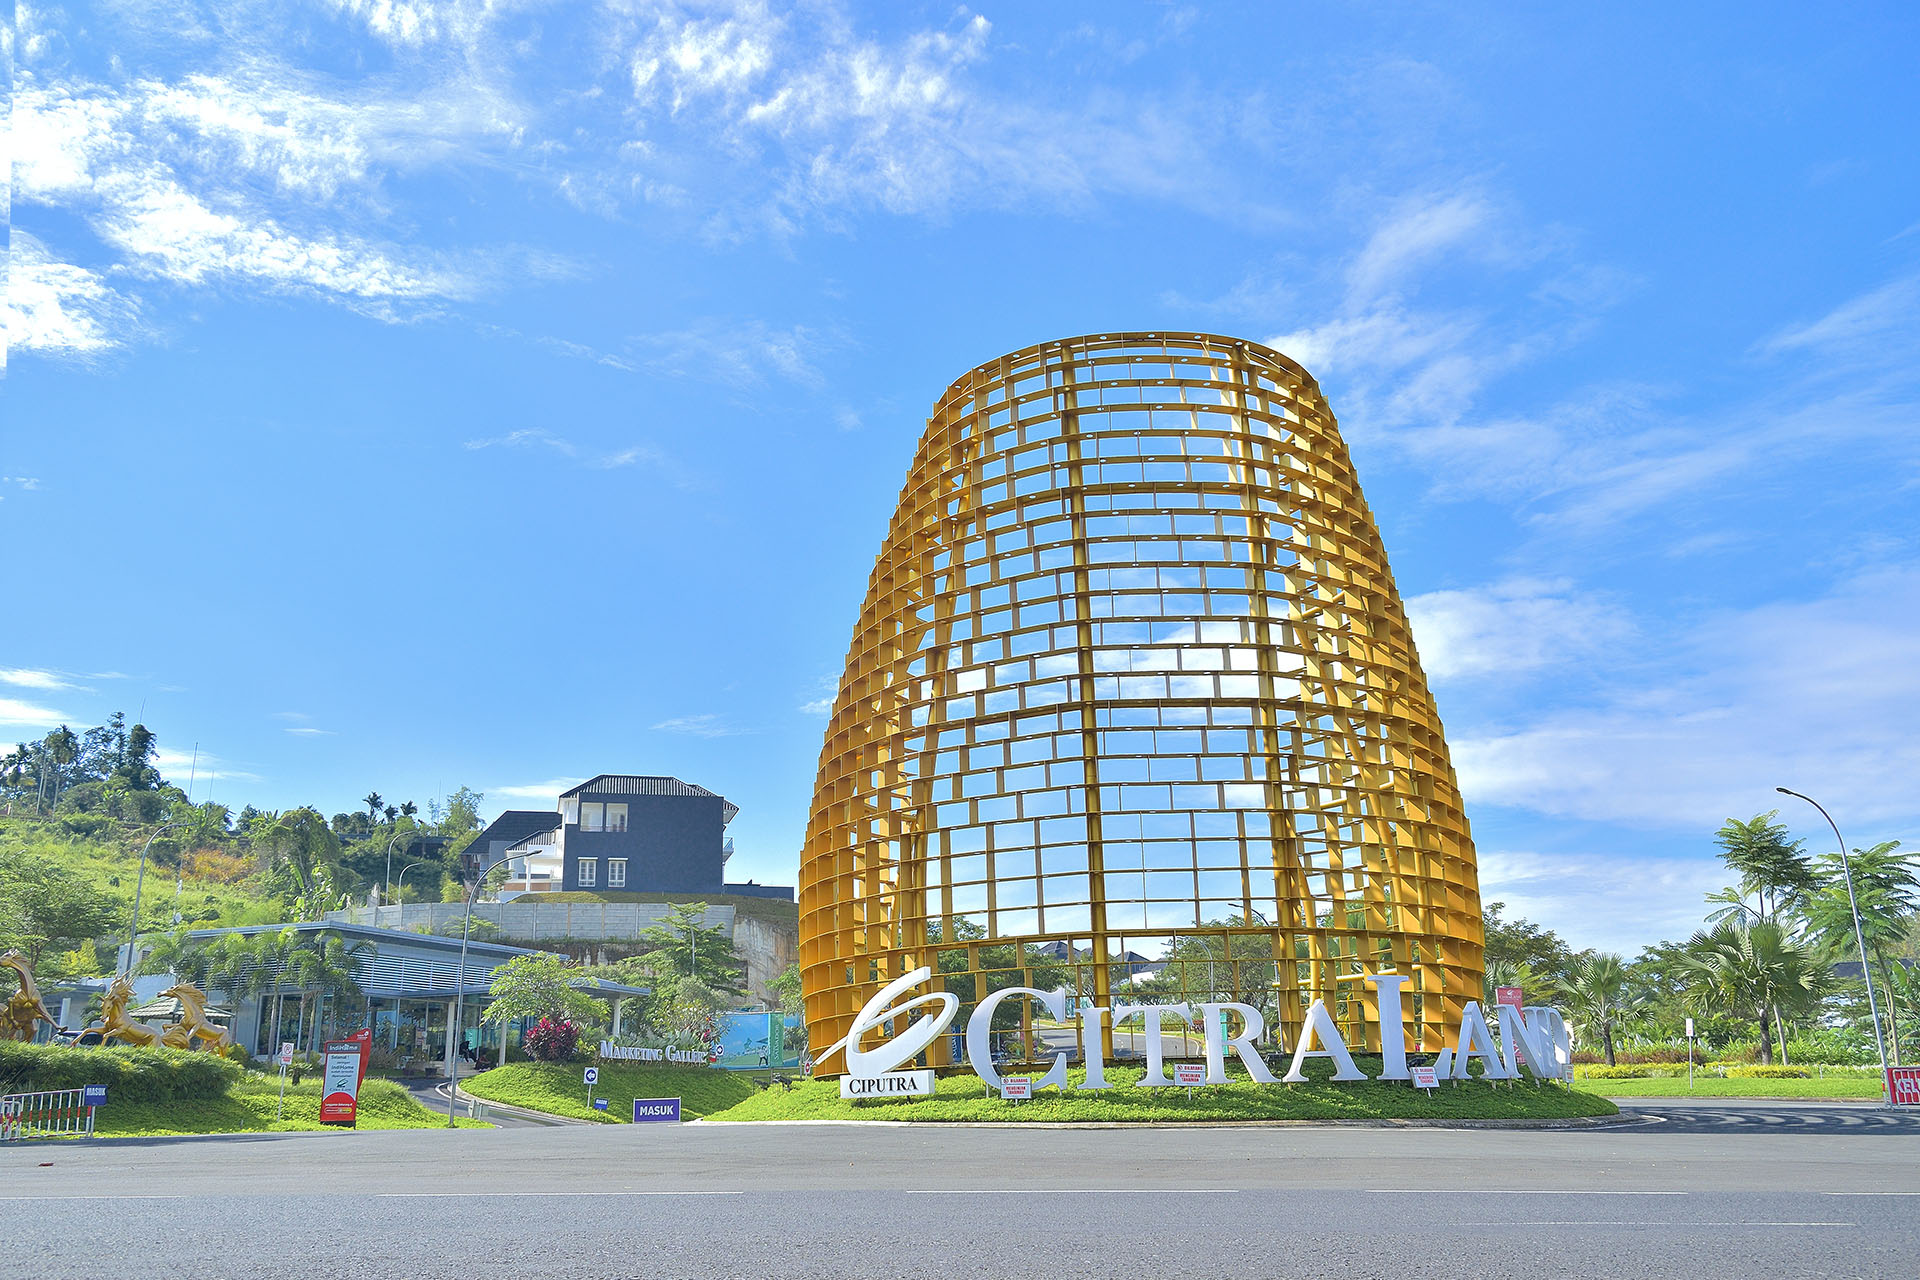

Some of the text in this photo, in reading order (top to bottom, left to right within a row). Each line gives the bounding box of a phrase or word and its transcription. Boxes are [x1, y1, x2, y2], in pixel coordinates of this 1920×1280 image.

[966, 975, 1570, 1090] CITRALAND
[600, 1040, 709, 1063] MARKETING GALLERY
[86, 1087, 106, 1096] MASUK
[849, 1076, 919, 1095] CIPUTRA
[640, 1105, 674, 1116] MASUK
